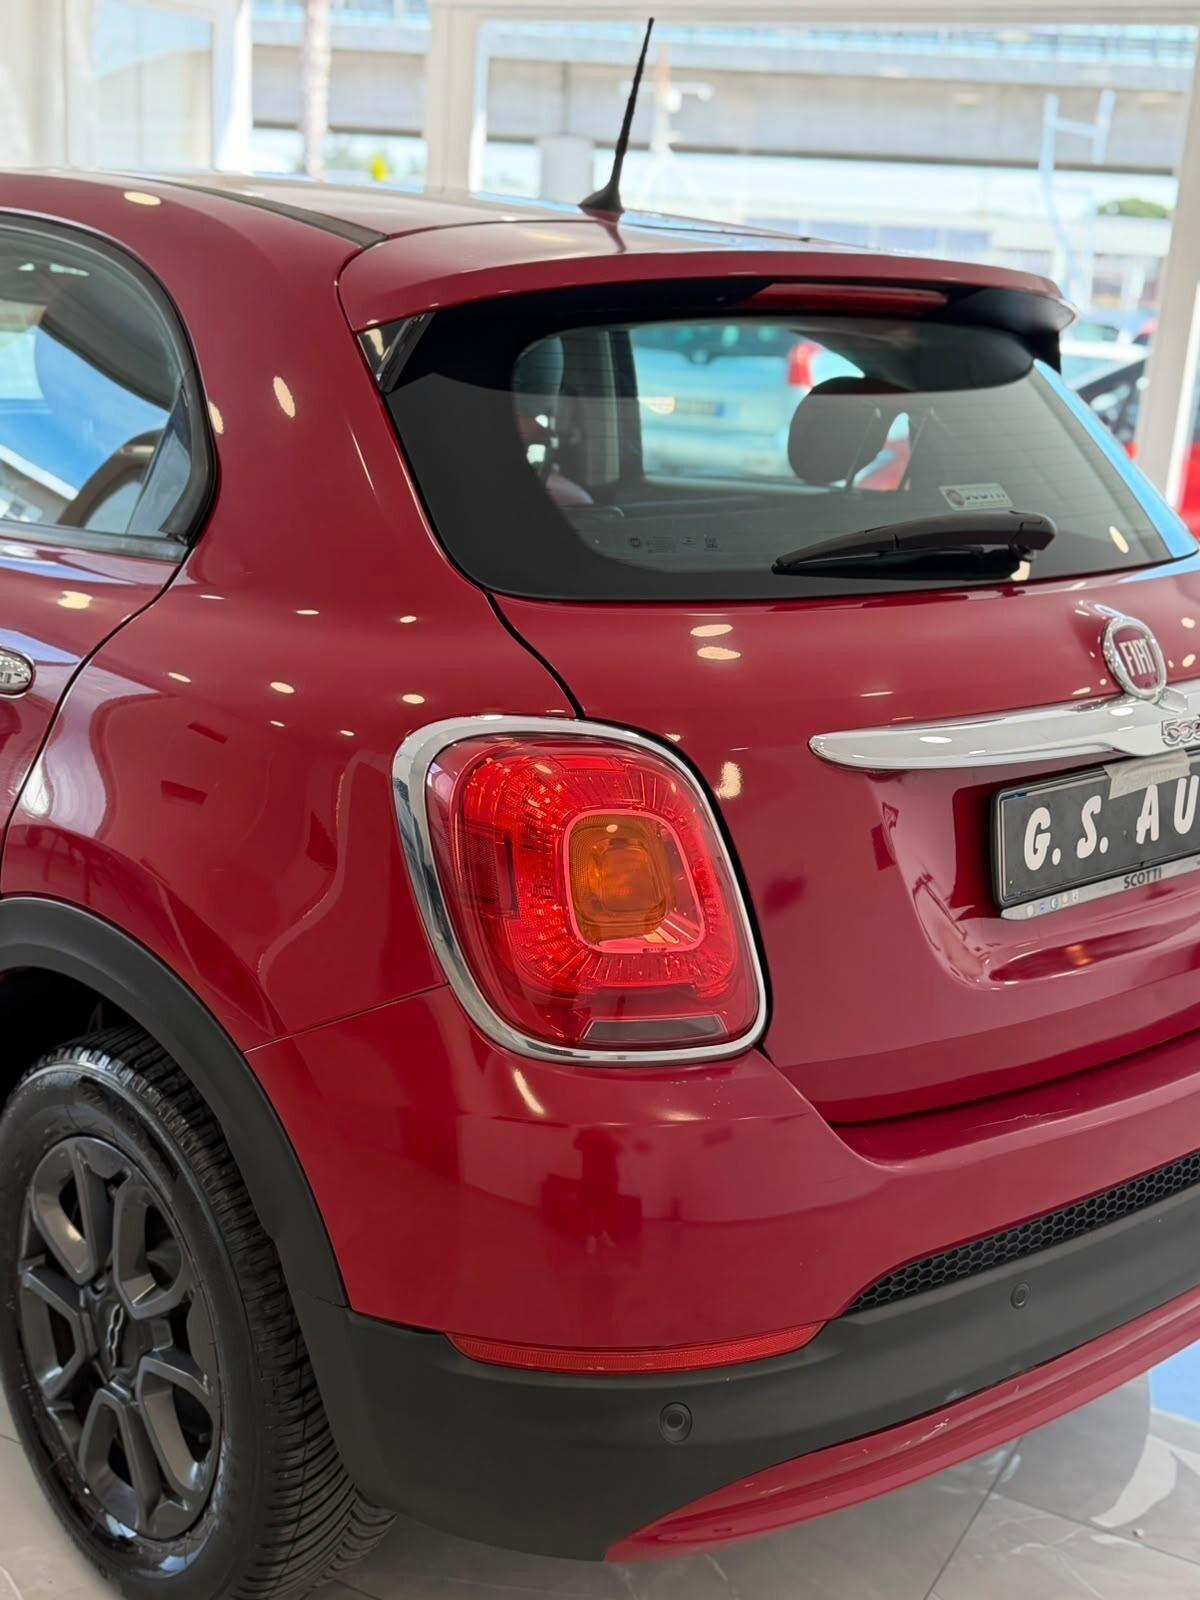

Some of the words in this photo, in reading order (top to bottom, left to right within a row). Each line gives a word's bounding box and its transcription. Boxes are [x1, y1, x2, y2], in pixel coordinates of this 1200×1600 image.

[1118, 638, 1156, 678] FIAT
[1023, 806, 1062, 871] G.
[1076, 794, 1109, 859] S.
[1123, 867, 1162, 889] SCOTTI
